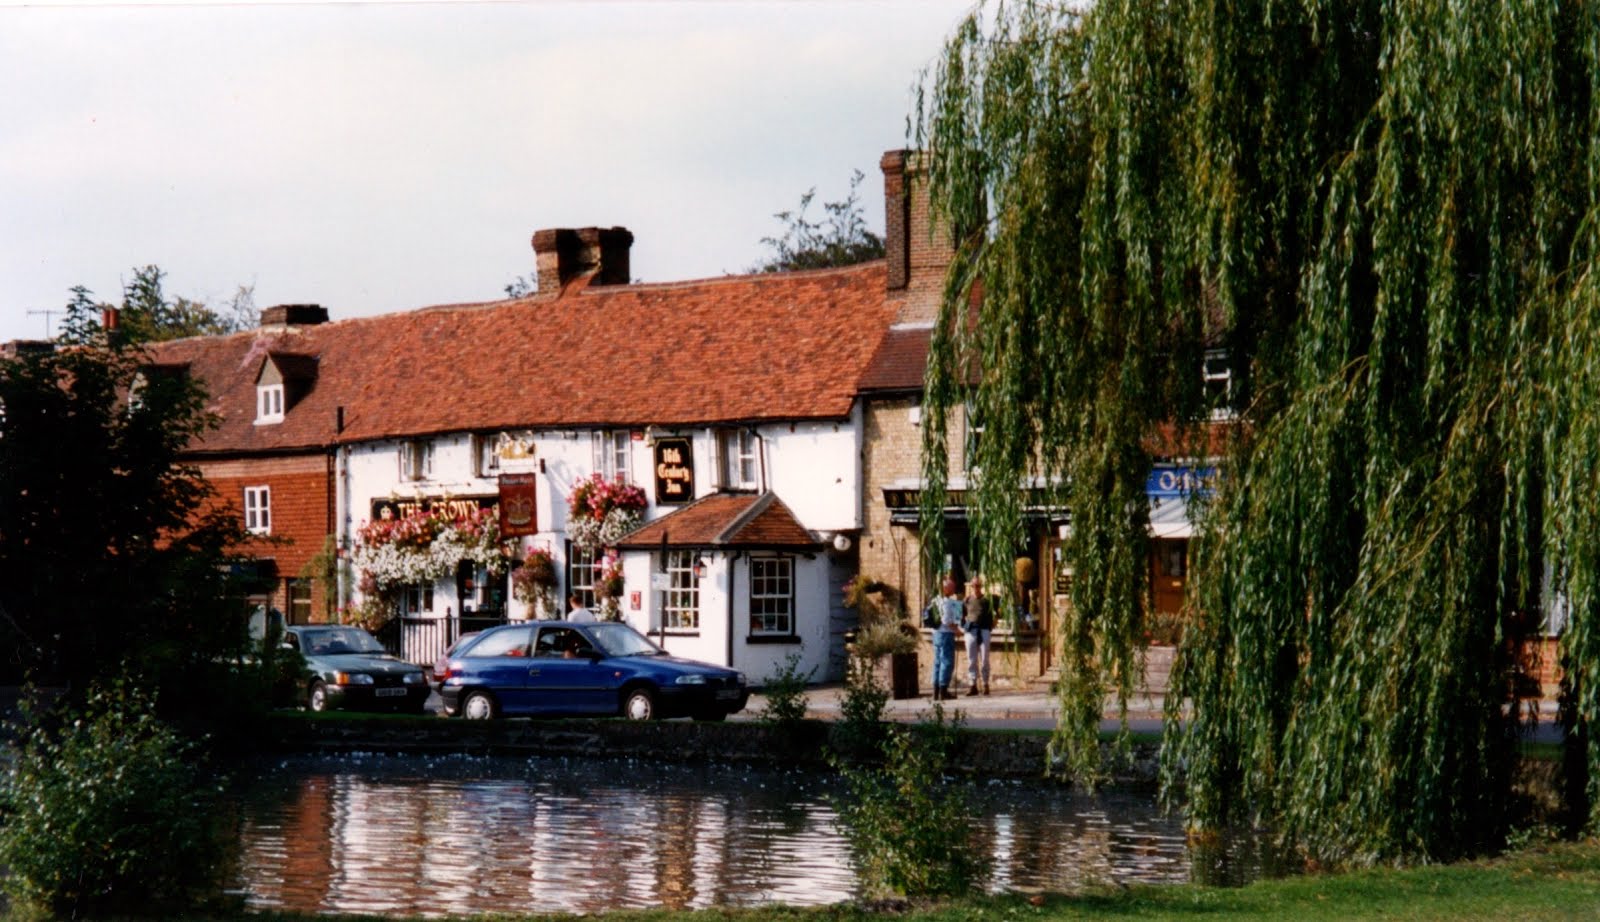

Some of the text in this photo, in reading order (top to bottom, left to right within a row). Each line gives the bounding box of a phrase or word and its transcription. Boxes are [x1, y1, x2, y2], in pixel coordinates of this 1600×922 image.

[666, 479, 682, 494] Inn
[397, 500, 479, 521] THE CROWN
